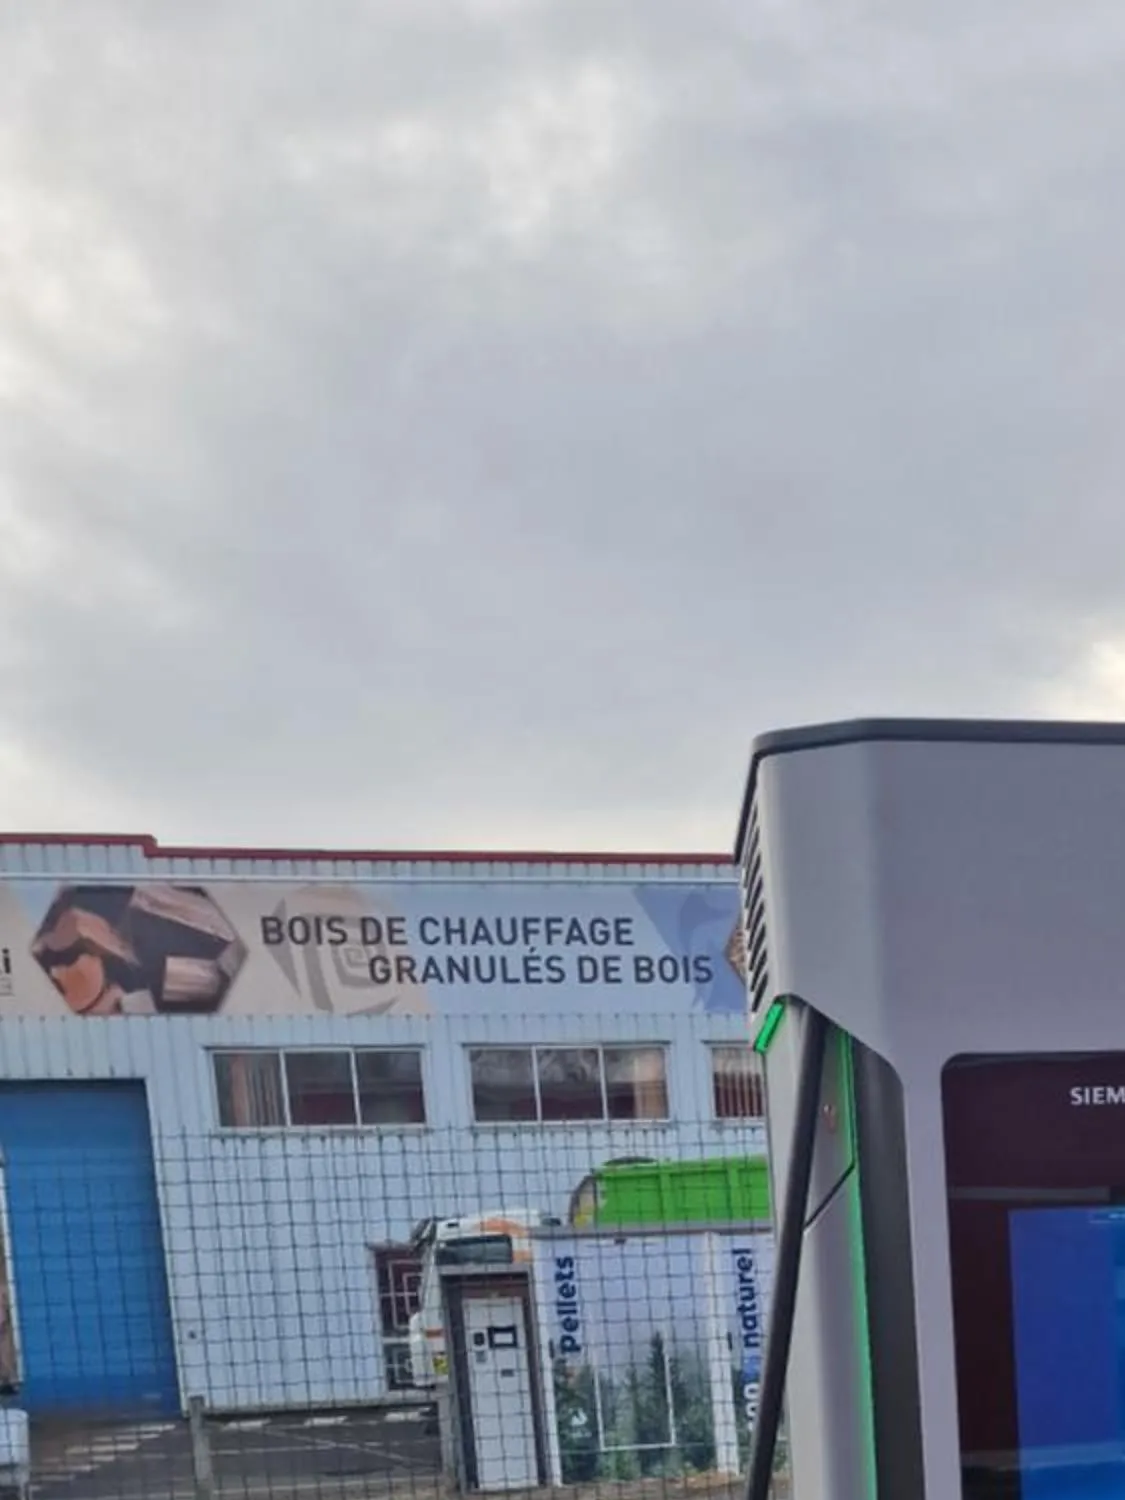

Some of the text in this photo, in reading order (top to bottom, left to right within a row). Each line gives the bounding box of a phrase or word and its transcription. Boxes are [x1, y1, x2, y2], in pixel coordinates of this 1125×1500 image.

[261, 916, 634, 946] BOIS DE CHAUFFAGE
[369, 947, 713, 985] GRANULÉS DE BOIS
[554, 1256, 582, 1355] pellets
[732, 1248, 760, 1349] naturel
